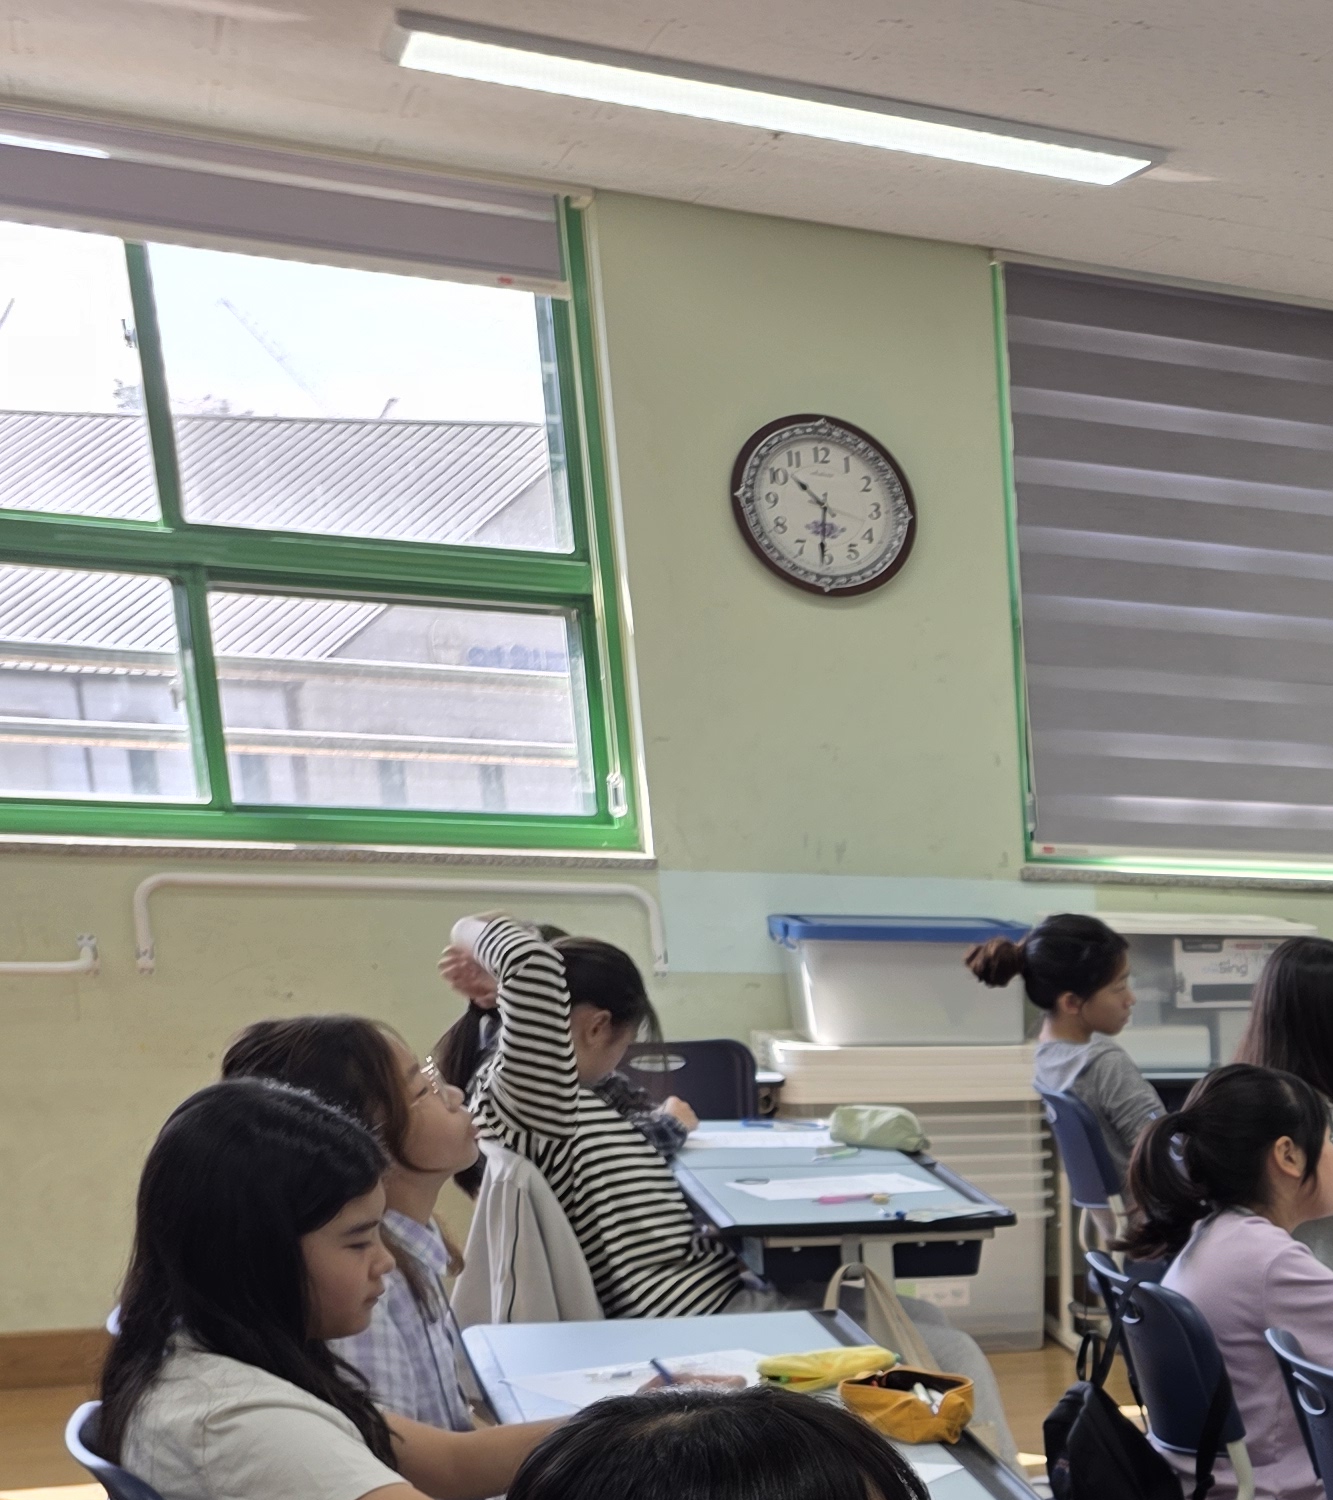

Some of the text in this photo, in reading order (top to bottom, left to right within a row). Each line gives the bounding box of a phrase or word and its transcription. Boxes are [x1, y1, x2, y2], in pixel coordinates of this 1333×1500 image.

[787, 450, 802, 468] 11
[813, 446, 831, 464] 12
[843, 456, 851, 473] 1
[769, 467, 790, 486] 10
[860, 476, 873, 492] 2
[765, 491, 780, 509] 9
[868, 502, 882, 520] 3
[773, 515, 788, 535] 8
[862, 528, 875, 544] 4
[794, 539, 807, 556] 7
[846, 543, 861, 560] 5
